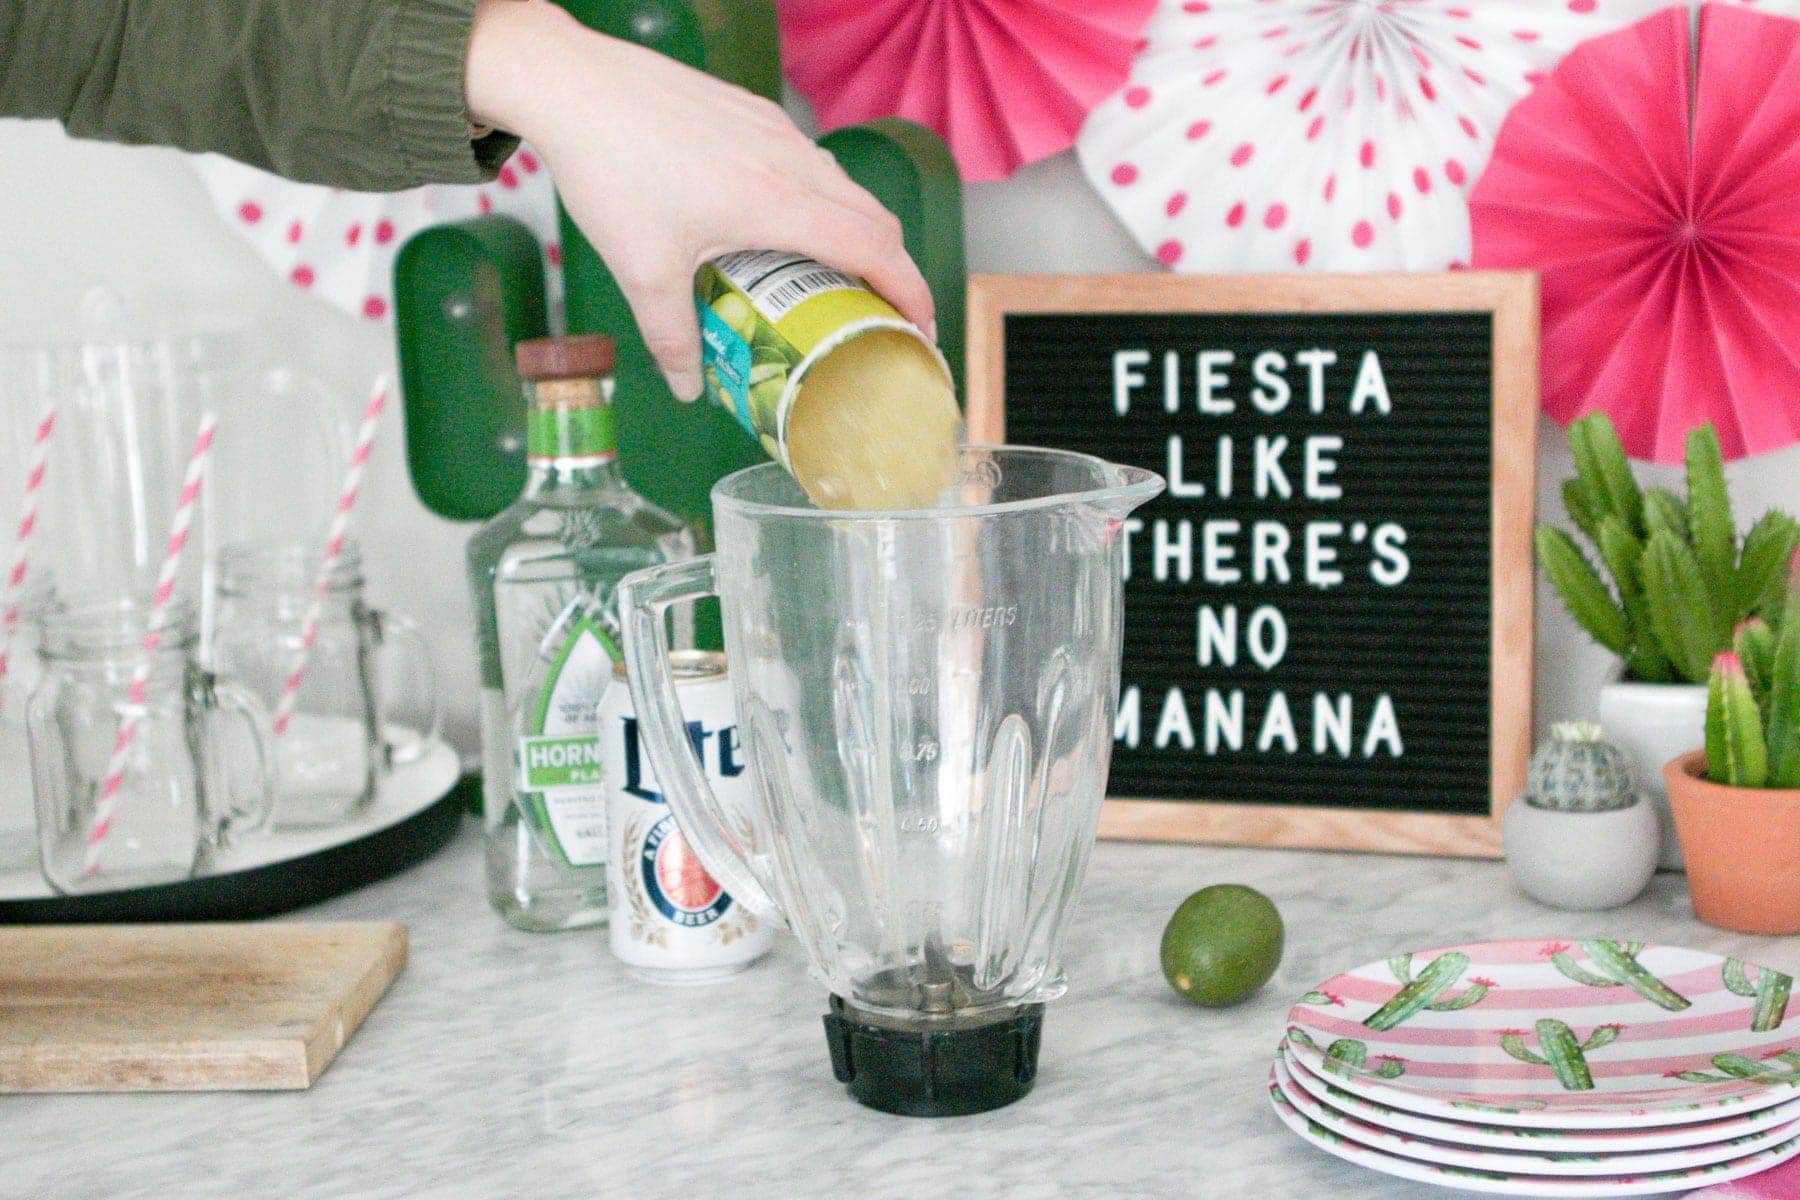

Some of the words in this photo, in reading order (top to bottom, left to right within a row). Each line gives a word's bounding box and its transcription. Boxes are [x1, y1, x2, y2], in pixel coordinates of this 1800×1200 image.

[1113, 348, 1392, 415] FIESTA
[1167, 434, 1344, 500] LIKE
[1122, 519, 1410, 589] THERE'S
[1197, 604, 1288, 672] NO
[1113, 684, 1404, 759] MANANA
[618, 715, 746, 804] Lte
[672, 907, 719, 926] BEER
